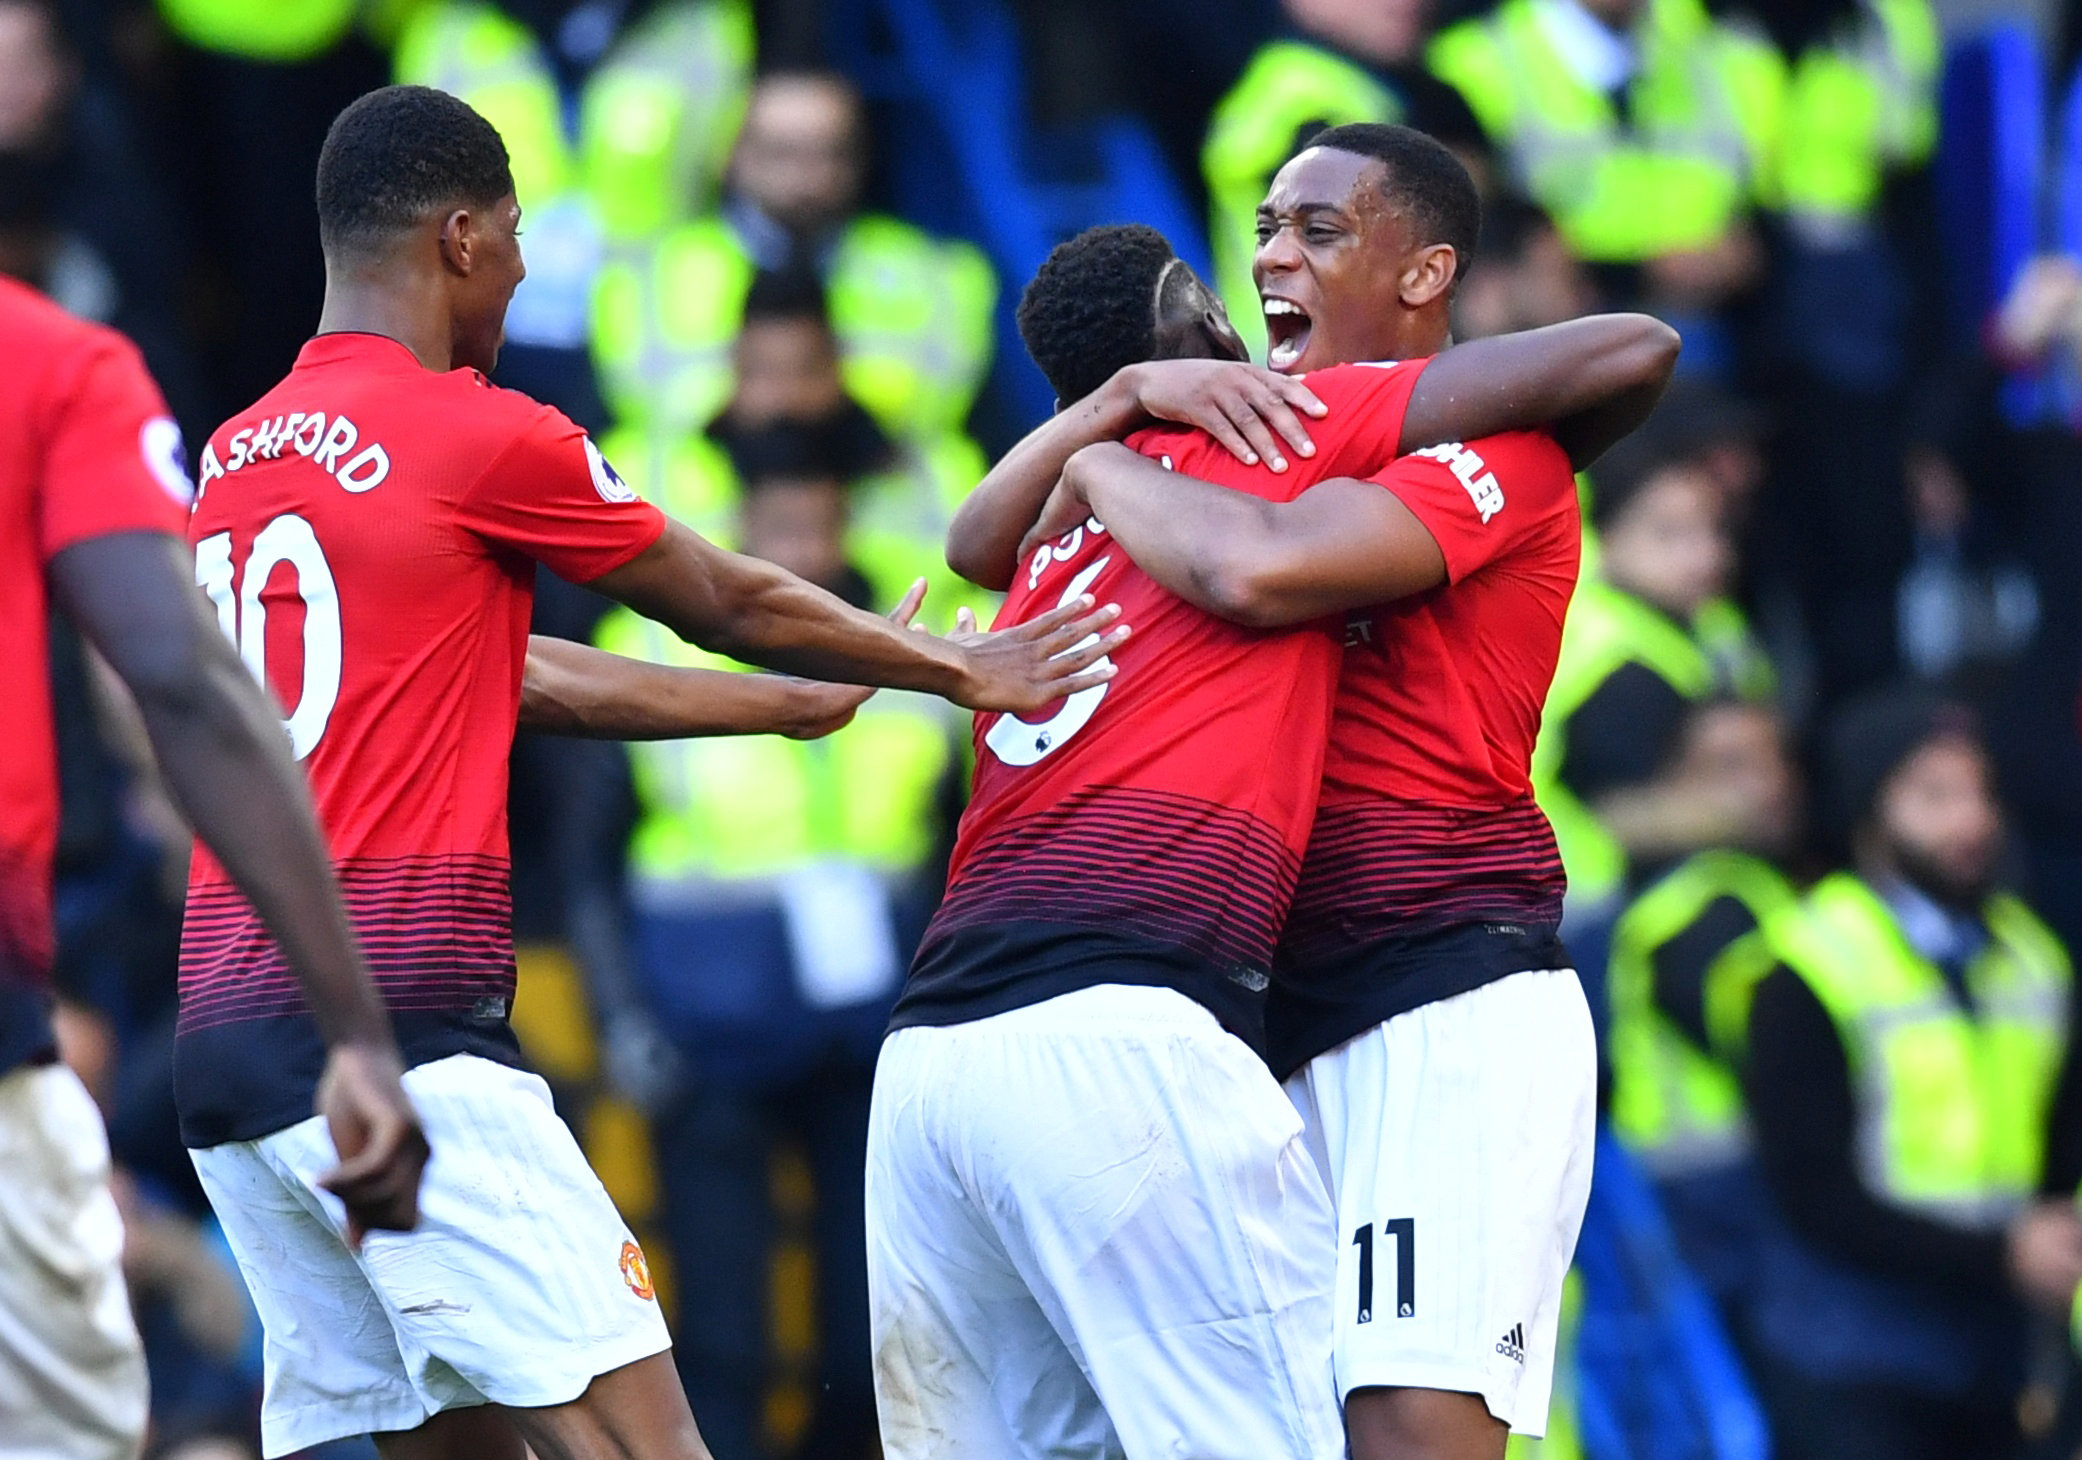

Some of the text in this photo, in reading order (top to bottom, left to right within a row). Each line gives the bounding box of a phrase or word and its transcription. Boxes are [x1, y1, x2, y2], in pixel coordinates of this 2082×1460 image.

[191, 411, 390, 511] ASHFORD
[1352, 1217, 1415, 1324] 11
[1495, 1342, 1525, 1365] adida
